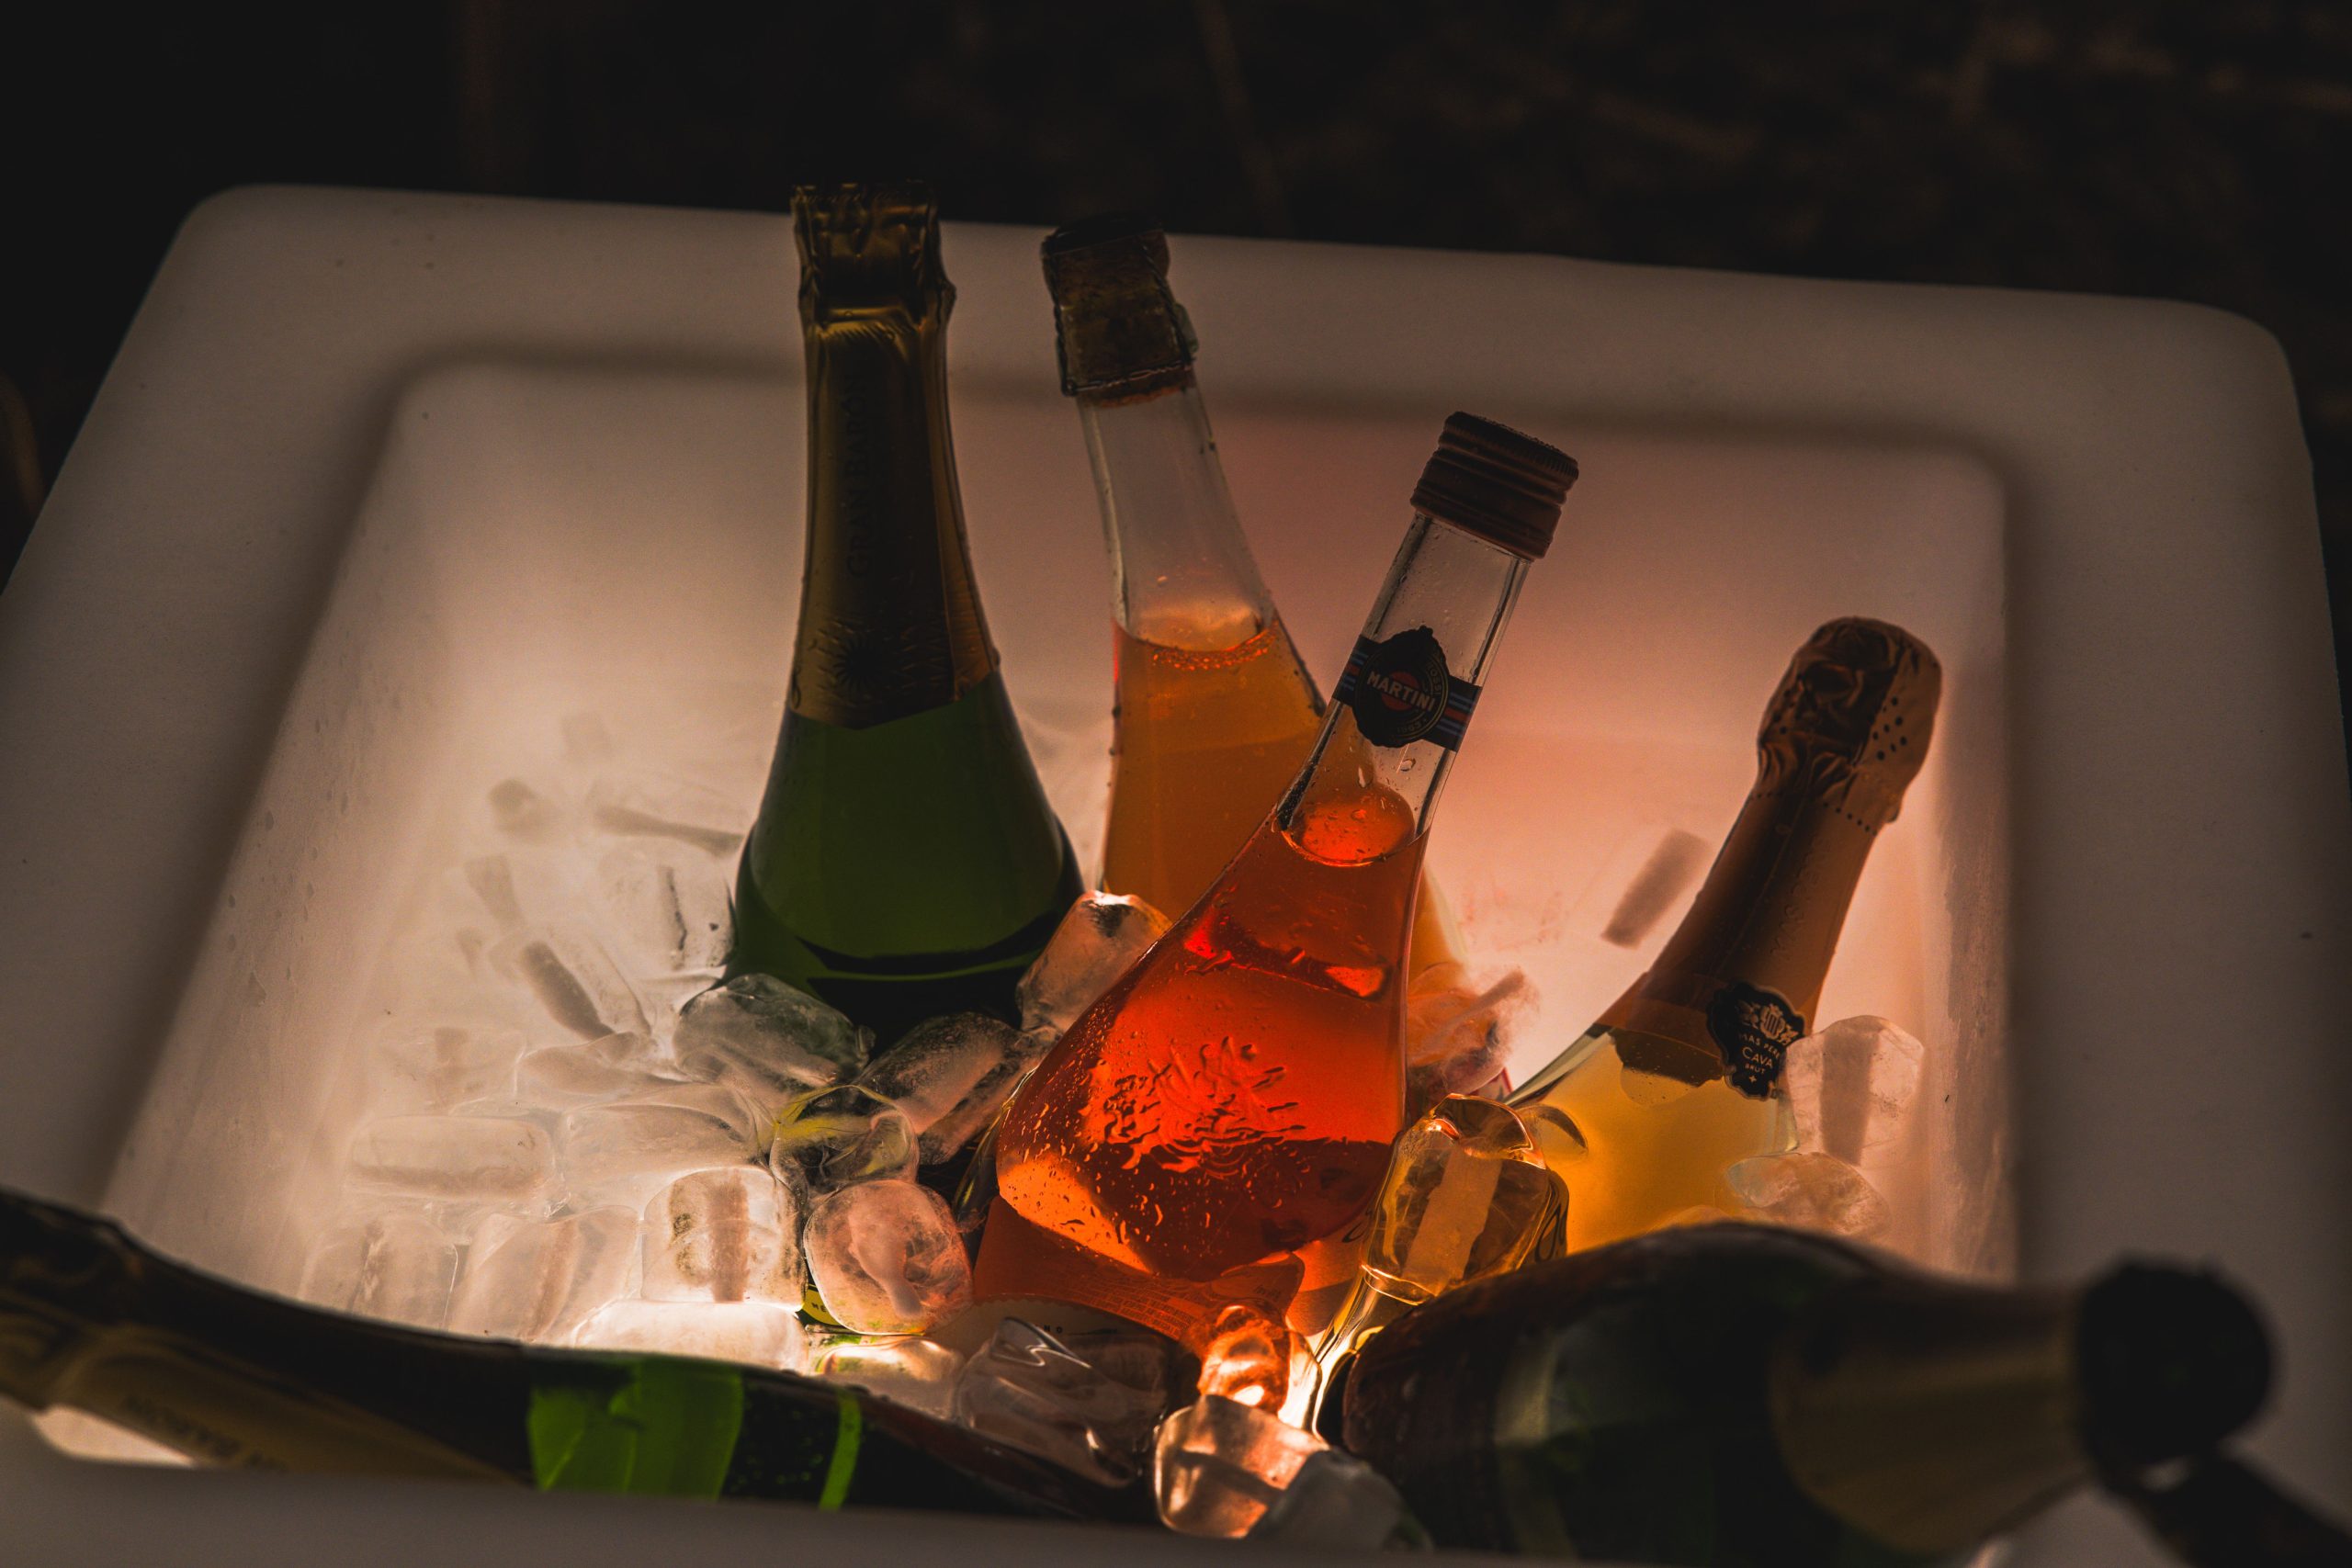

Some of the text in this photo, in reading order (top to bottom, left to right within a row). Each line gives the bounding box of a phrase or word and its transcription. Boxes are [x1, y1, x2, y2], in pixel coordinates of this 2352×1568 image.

[846, 489, 868, 578] GRAN
[1366, 670, 1436, 712] MARTINI
[1742, 1046, 1773, 1069] CAVA
[1744, 1063, 1767, 1075] BRUT
